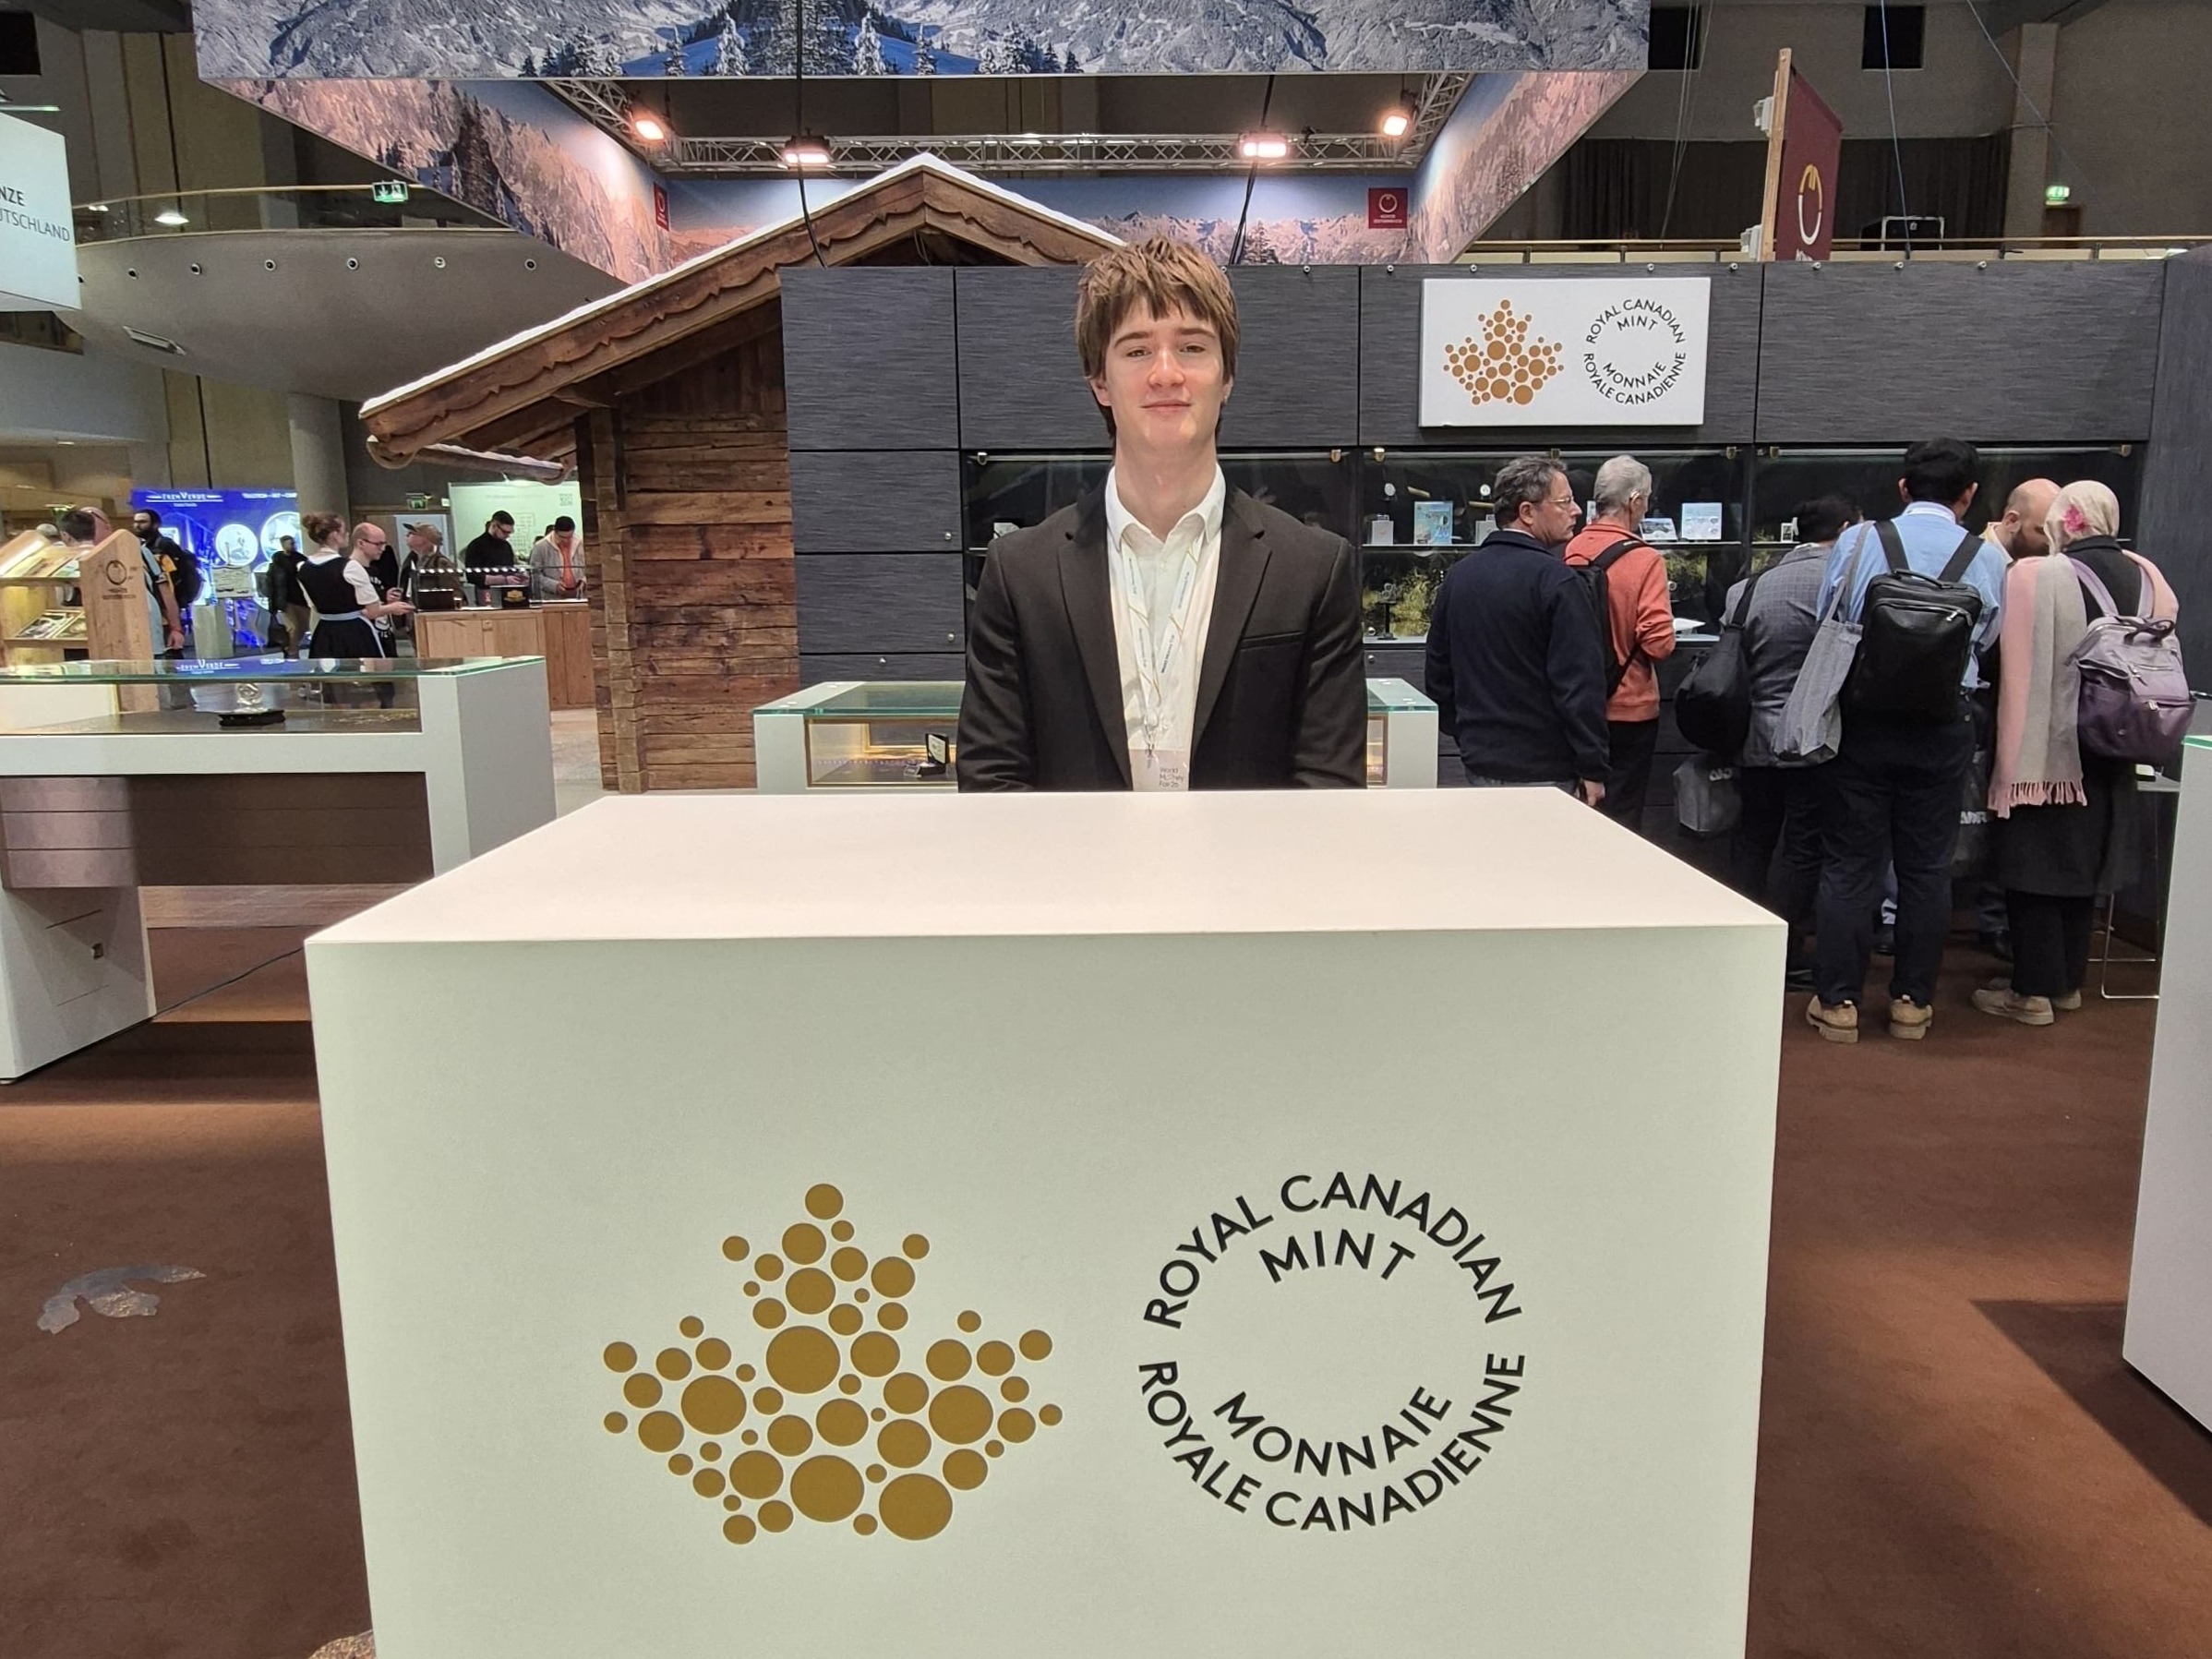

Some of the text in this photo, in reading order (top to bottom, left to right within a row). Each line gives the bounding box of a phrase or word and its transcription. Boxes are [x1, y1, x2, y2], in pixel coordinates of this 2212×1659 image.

[1586, 298, 1686, 343] ROYAL CANADIAN
[1617, 316, 1658, 331] MINT
[1584, 352, 1686, 404] ROYALE CANADIENNE
[1603, 361, 1666, 388] MONNAIE
[1143, 1172, 1522, 1329] ROYAL CANADIAN
[1258, 1229, 1416, 1284] MINT
[1138, 1353, 1525, 1532] ROYALE CANADIENNE
[1213, 1386, 1452, 1477] MONNAIE
